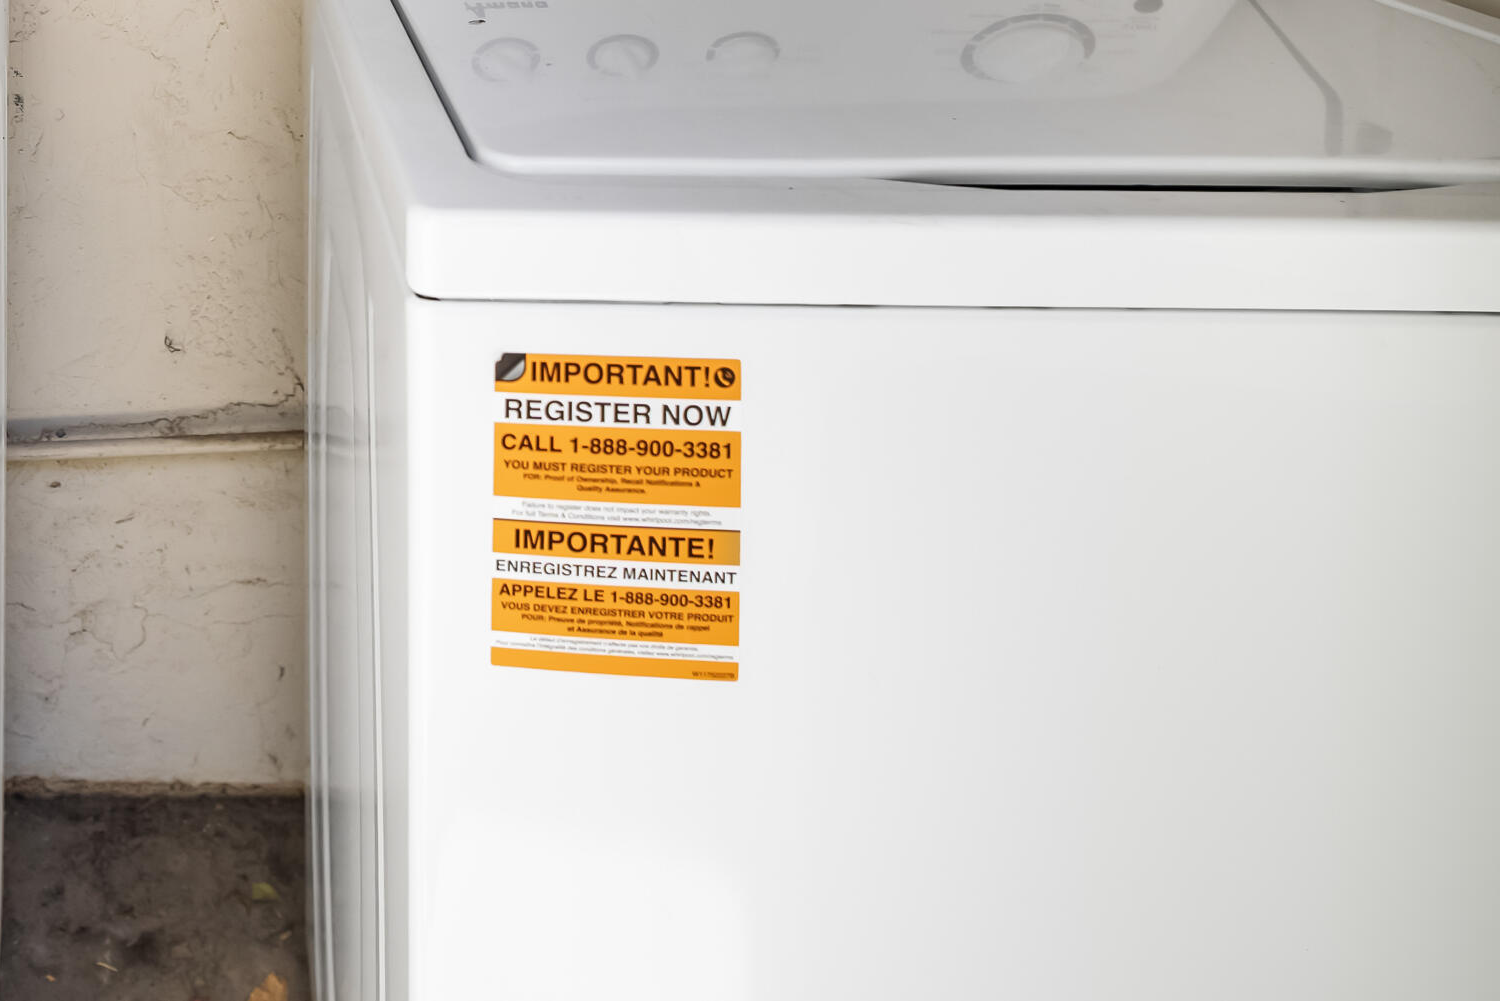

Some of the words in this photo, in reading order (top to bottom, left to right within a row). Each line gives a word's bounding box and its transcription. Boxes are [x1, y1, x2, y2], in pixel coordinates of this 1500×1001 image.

[532, 362, 710, 388] IMPORTANT!
[504, 398, 651, 424] REGISTER
[662, 404, 731, 426] NOW
[501, 434, 562, 452] CALL
[570, 437, 731, 459] 1-888-900-3381
[504, 460, 529, 470] YOU
[533, 461, 566, 471] MUST
[571, 464, 632, 474] REGISTER
[636, 466, 670, 476] YOUR
[674, 468, 734, 478] PRODUCT
[515, 529, 714, 559] IMPORTANTE!
[496, 559, 617, 578] ENREGISTREZ
[623, 567, 737, 584] MAINTENANT
[500, 584, 578, 600] APPELEZ
[584, 589, 604, 602] LE
[611, 591, 731, 608] 1-888-900-3381
[501, 601, 530, 610] VOUS
[533, 604, 568, 613] DEVEZ
[571, 606, 645, 618] ENREGISTRER
[649, 612, 684, 620] VOTRE
[687, 613, 734, 623] PRODUIT
[577, 626, 616, 634] Assurance
[626, 621, 673, 629] Notifications
